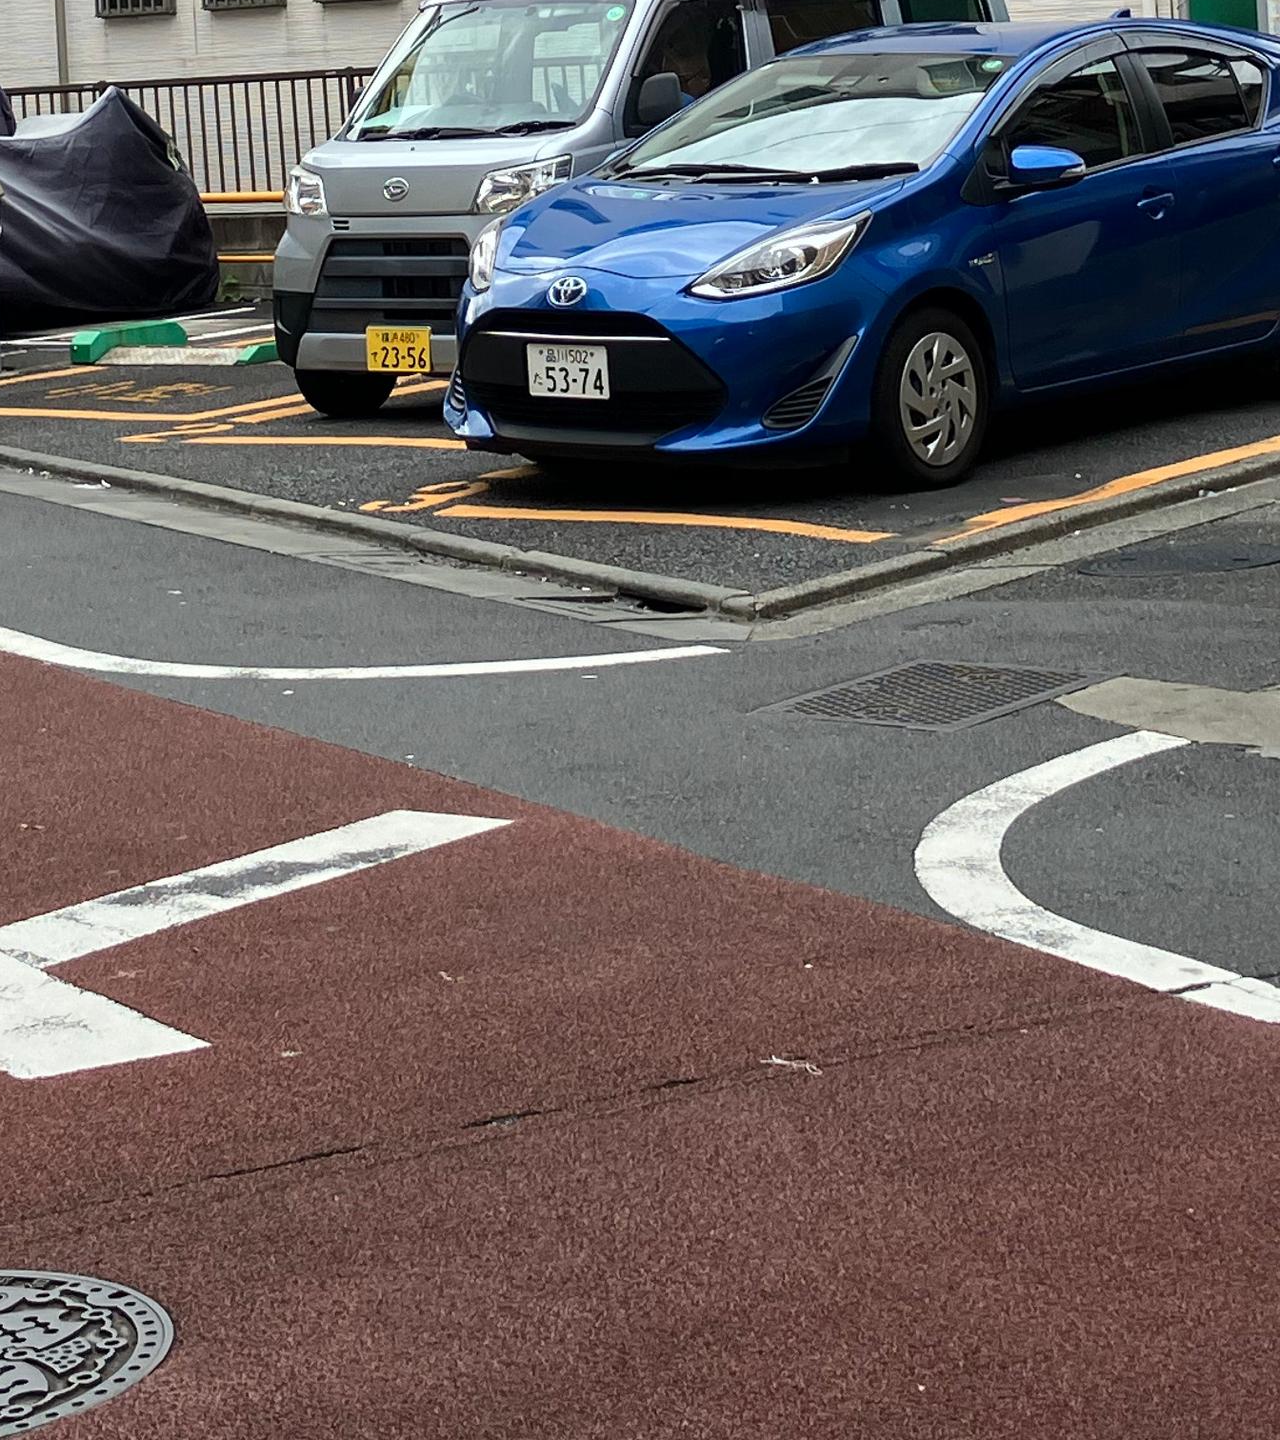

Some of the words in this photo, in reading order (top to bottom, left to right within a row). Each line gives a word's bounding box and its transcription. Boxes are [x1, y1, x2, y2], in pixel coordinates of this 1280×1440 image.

[381, 346, 426, 369] 23-56
[546, 348, 588, 364] 品川502
[545, 366, 604, 395] 53-74
